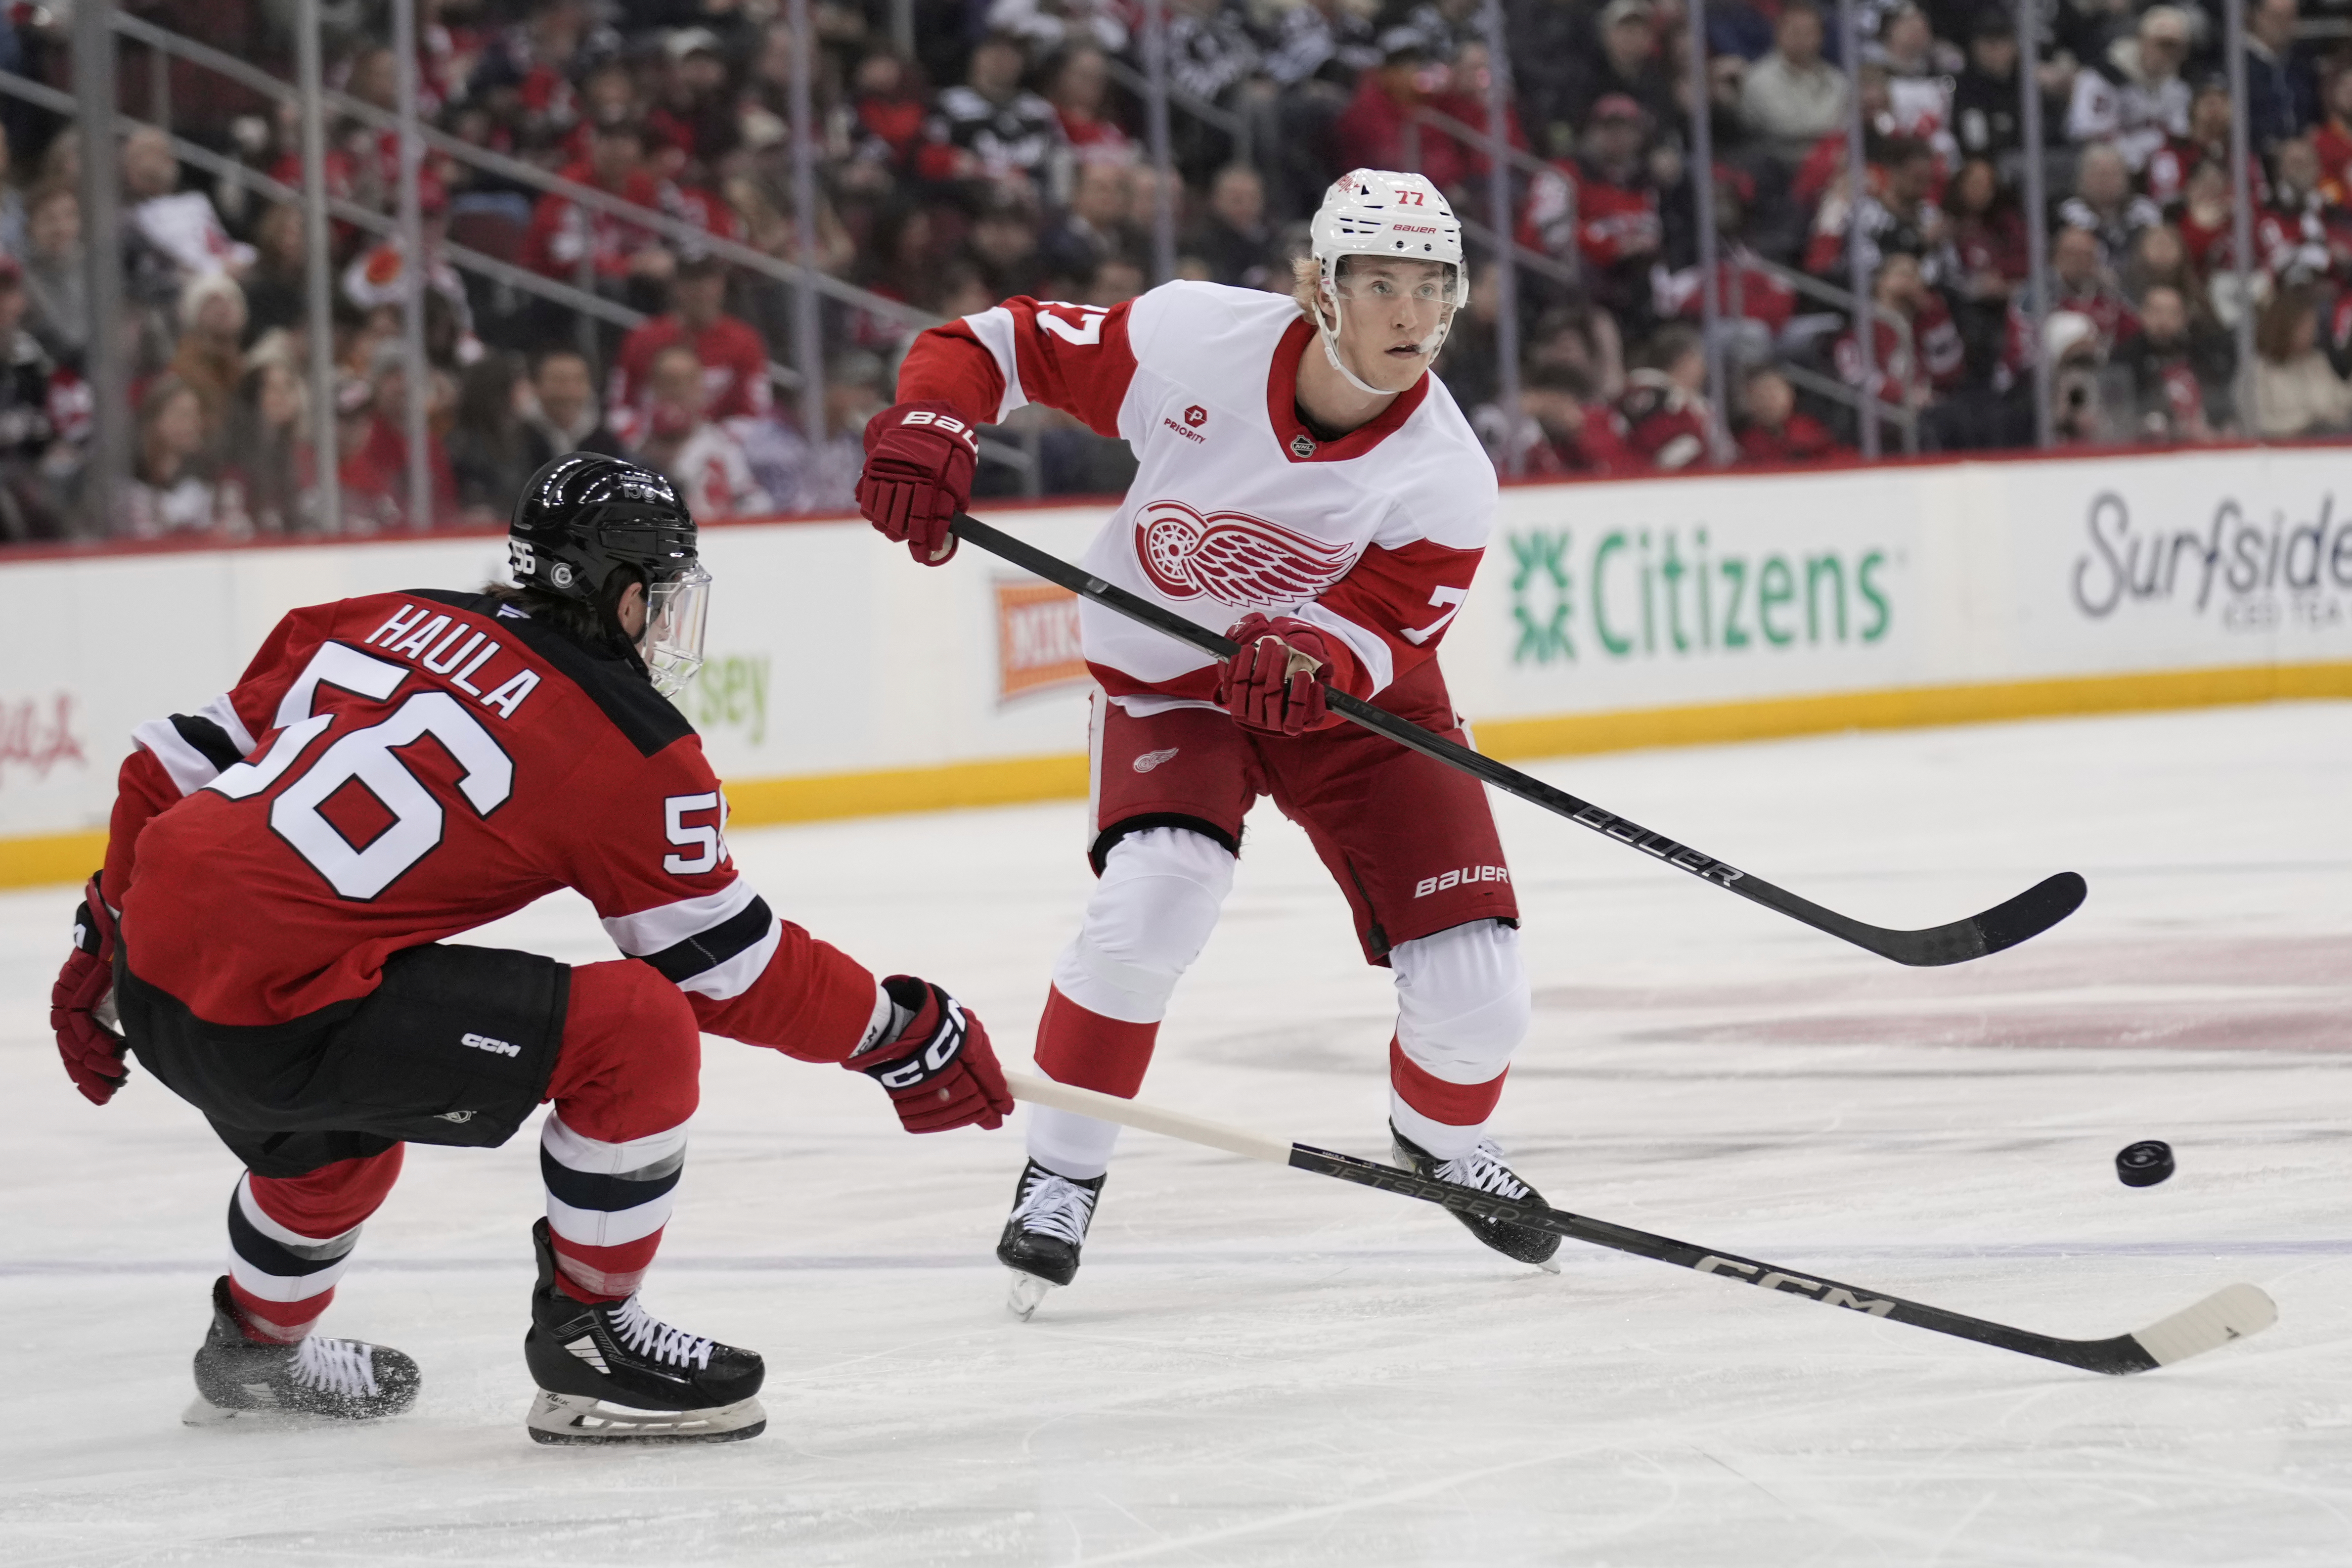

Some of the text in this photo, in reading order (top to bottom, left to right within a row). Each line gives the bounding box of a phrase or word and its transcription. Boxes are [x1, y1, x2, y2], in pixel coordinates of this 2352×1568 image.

[1393, 224, 1436, 234] BAUER
[1395, 190, 1424, 206] 77
[1164, 418, 1206, 444] PRIORITY
[512, 539, 535, 575] 56
[2072, 491, 2352, 620] Surfside
[1592, 527, 1893, 656] Citizens
[364, 603, 542, 720] HAULA
[198, 640, 515, 902] 56
[663, 786, 728, 875] 5
[1573, 805, 1744, 887] BAUER
[1414, 865, 1509, 898] BAUER
[461, 1032, 522, 1058] CCM
[1693, 1255, 1896, 1318] CCM
